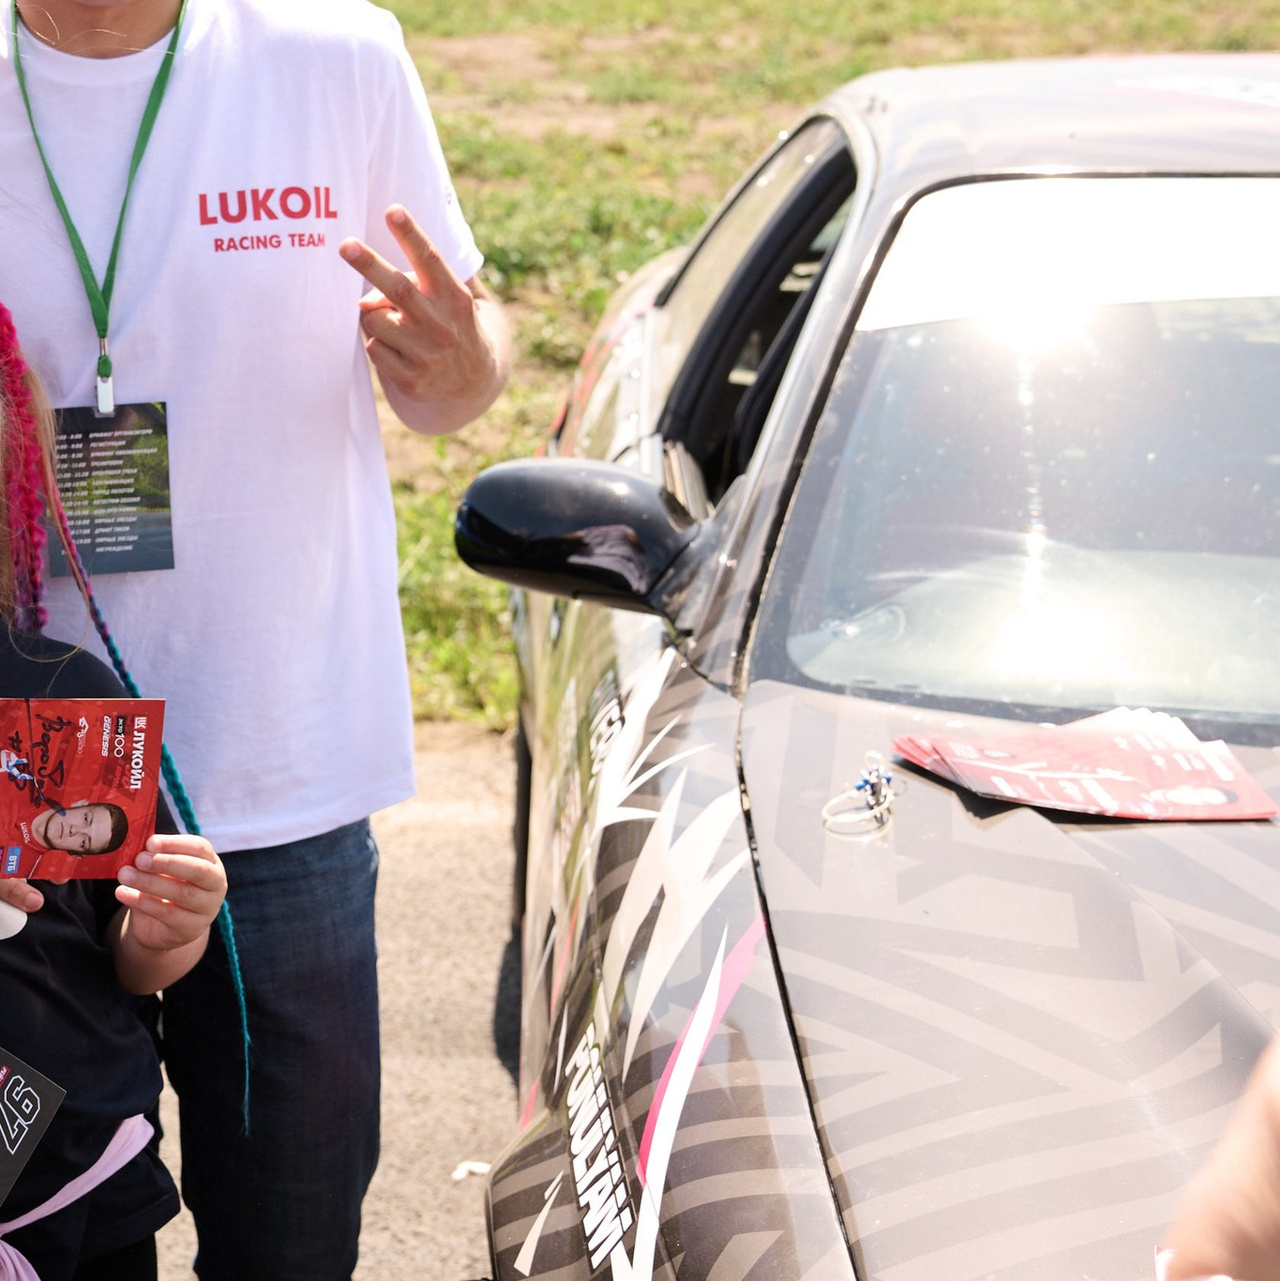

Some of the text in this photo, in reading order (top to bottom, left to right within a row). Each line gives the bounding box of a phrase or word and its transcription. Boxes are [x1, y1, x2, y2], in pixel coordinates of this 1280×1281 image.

[199, 186, 337, 225] LUKOIL
[214, 233, 325, 252] RACING TEAM
[101, 715, 112, 758] GENESIS
[114, 733, 125, 758] 100
[130, 731, 147, 790] ЛУКОЙЛ
[6, 855, 18, 872] ВТБ
